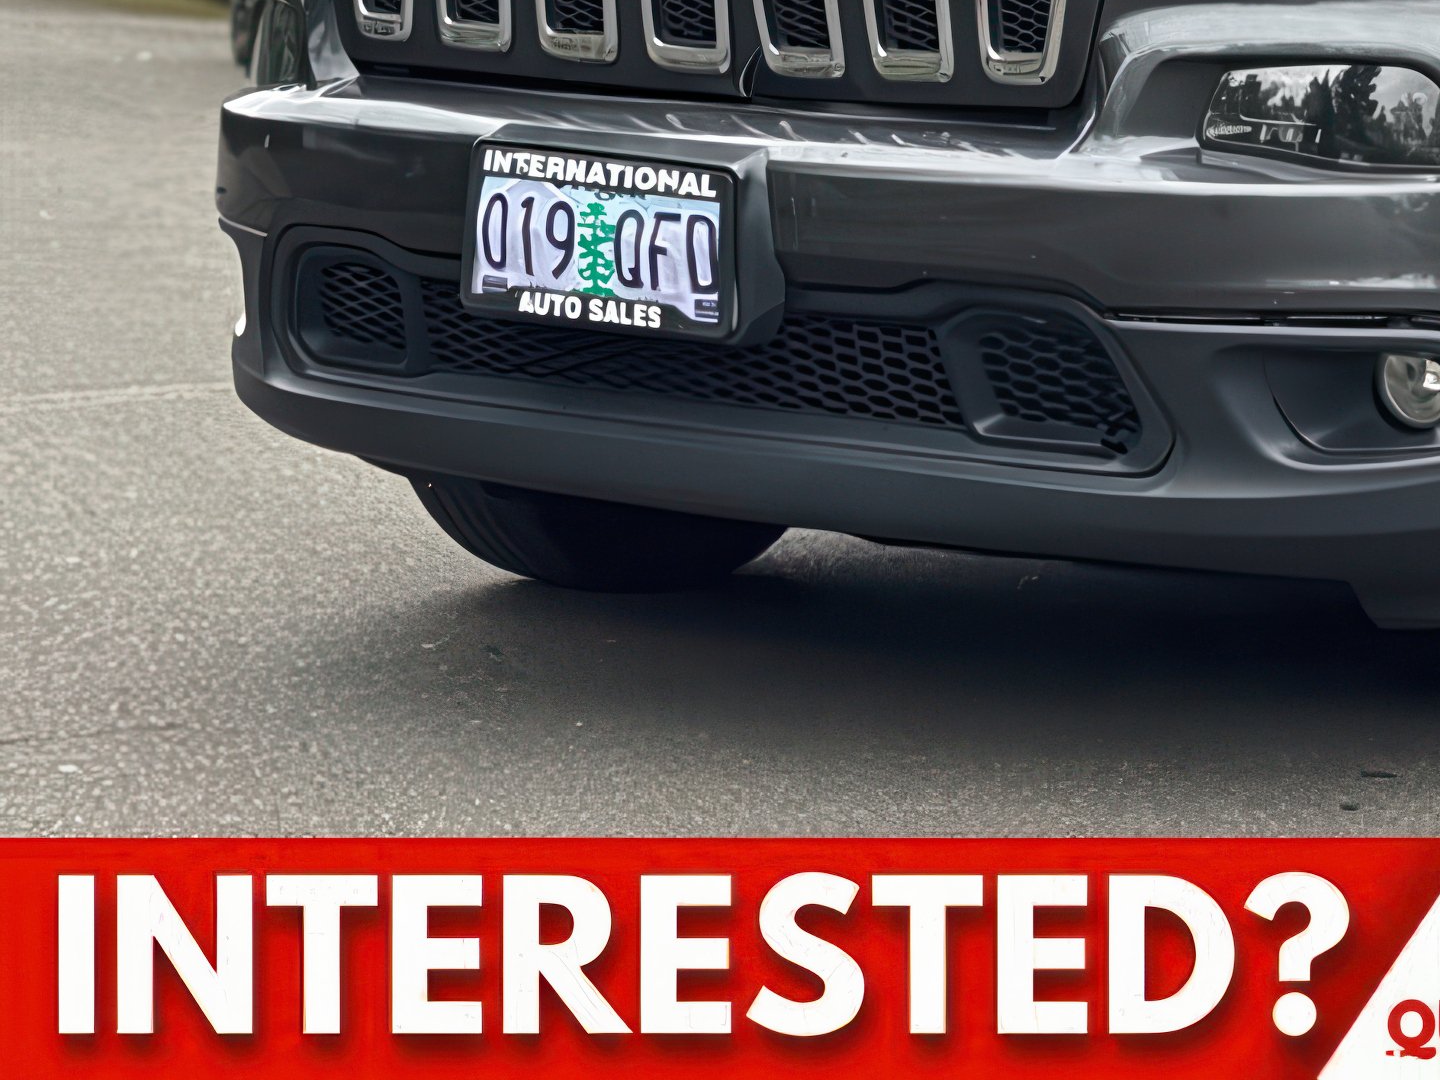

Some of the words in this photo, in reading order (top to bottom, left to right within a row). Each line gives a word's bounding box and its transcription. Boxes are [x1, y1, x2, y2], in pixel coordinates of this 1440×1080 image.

[483, 149, 717, 198] INTERNATIONAL
[482, 192, 575, 280] 019
[518, 291, 582, 319] AUTO
[588, 298, 661, 329] SALES
